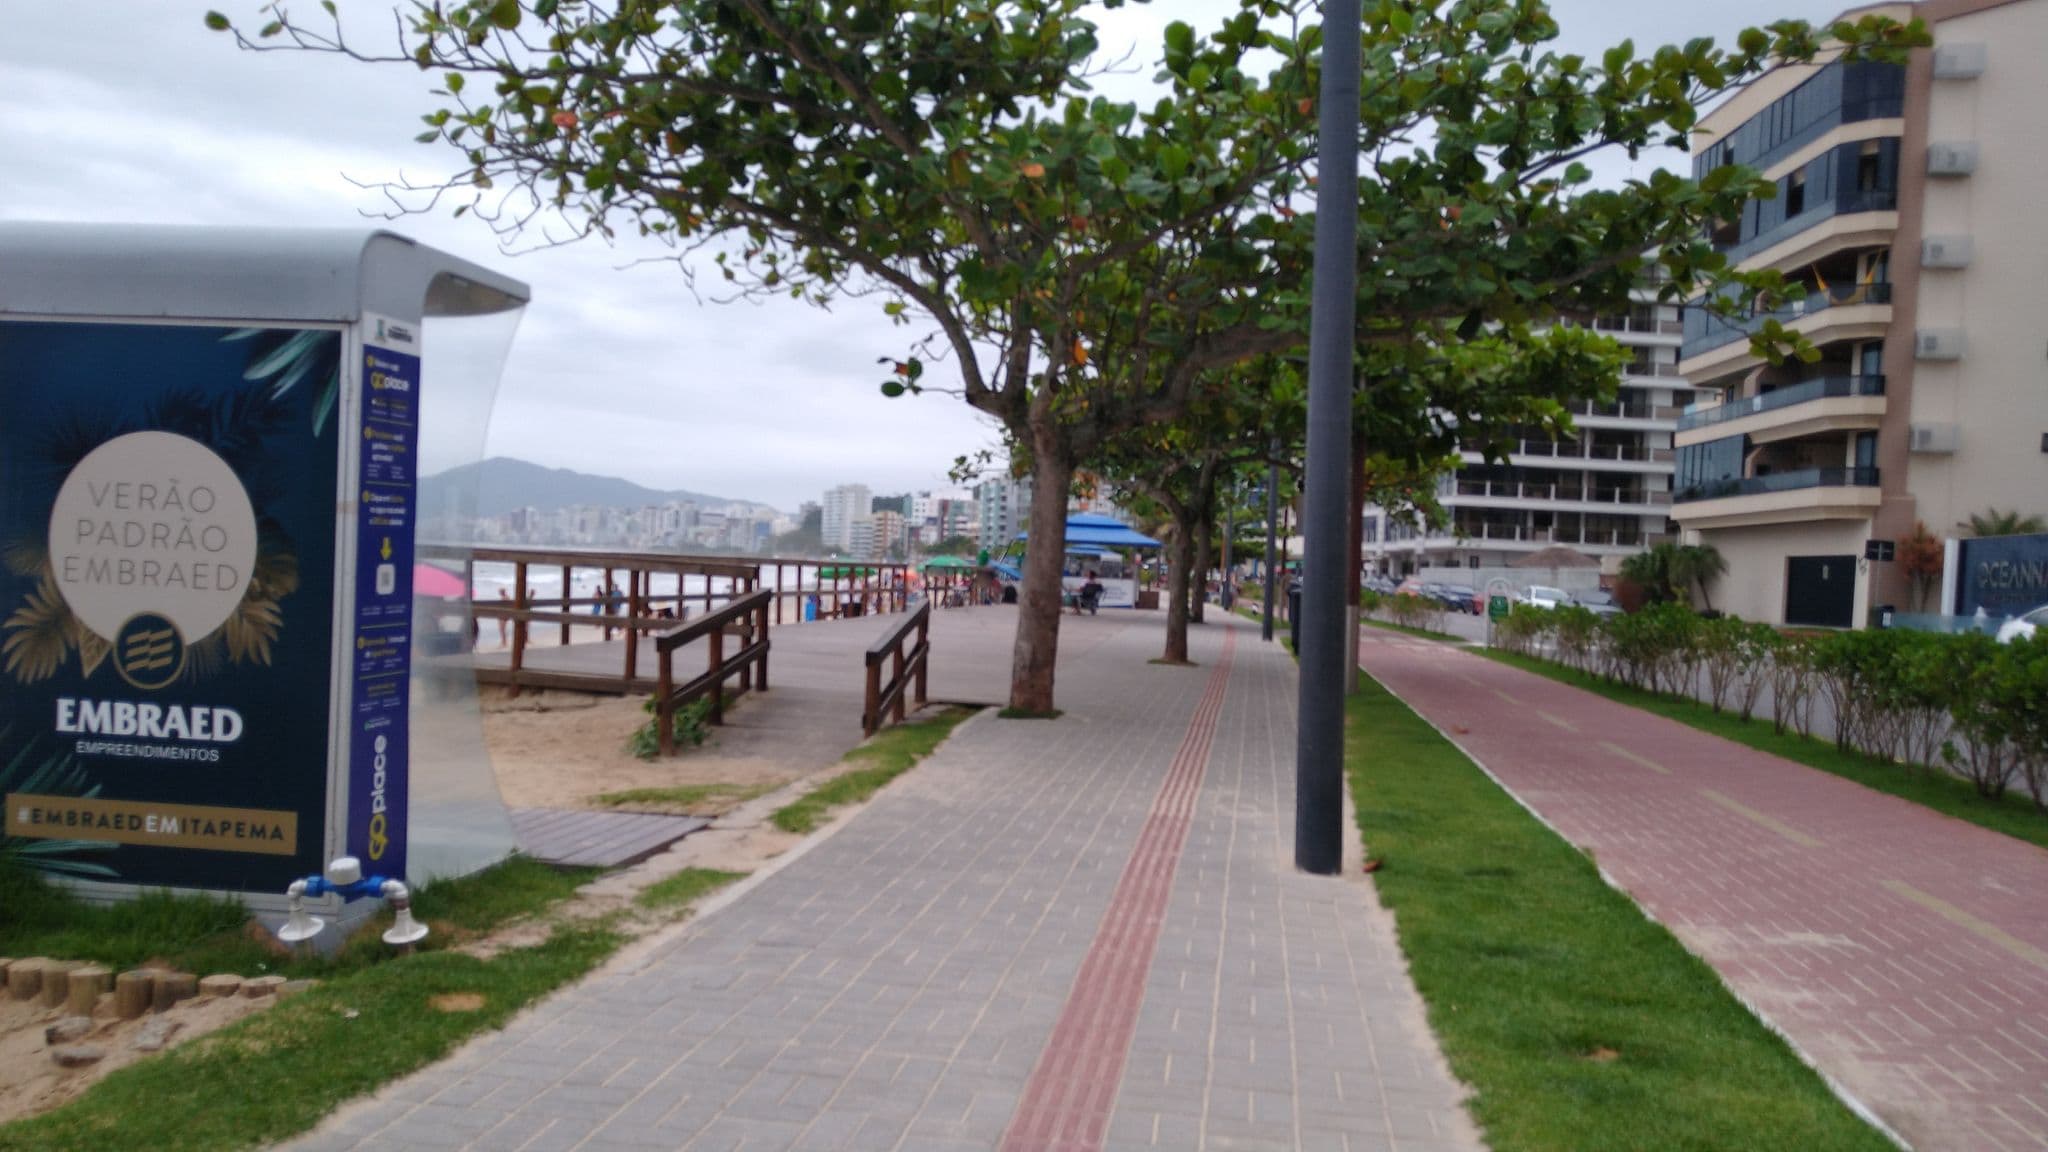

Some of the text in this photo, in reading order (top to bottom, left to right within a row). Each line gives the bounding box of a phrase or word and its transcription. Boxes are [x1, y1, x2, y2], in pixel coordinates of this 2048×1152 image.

[88, 478, 215, 513] VERÃO
[77, 517, 228, 552] PADRÃO
[64, 556, 239, 591] EMBRAED
[55, 698, 243, 742] EMBRAED
[76, 741, 220, 761] EMPREENDIMENTOS
